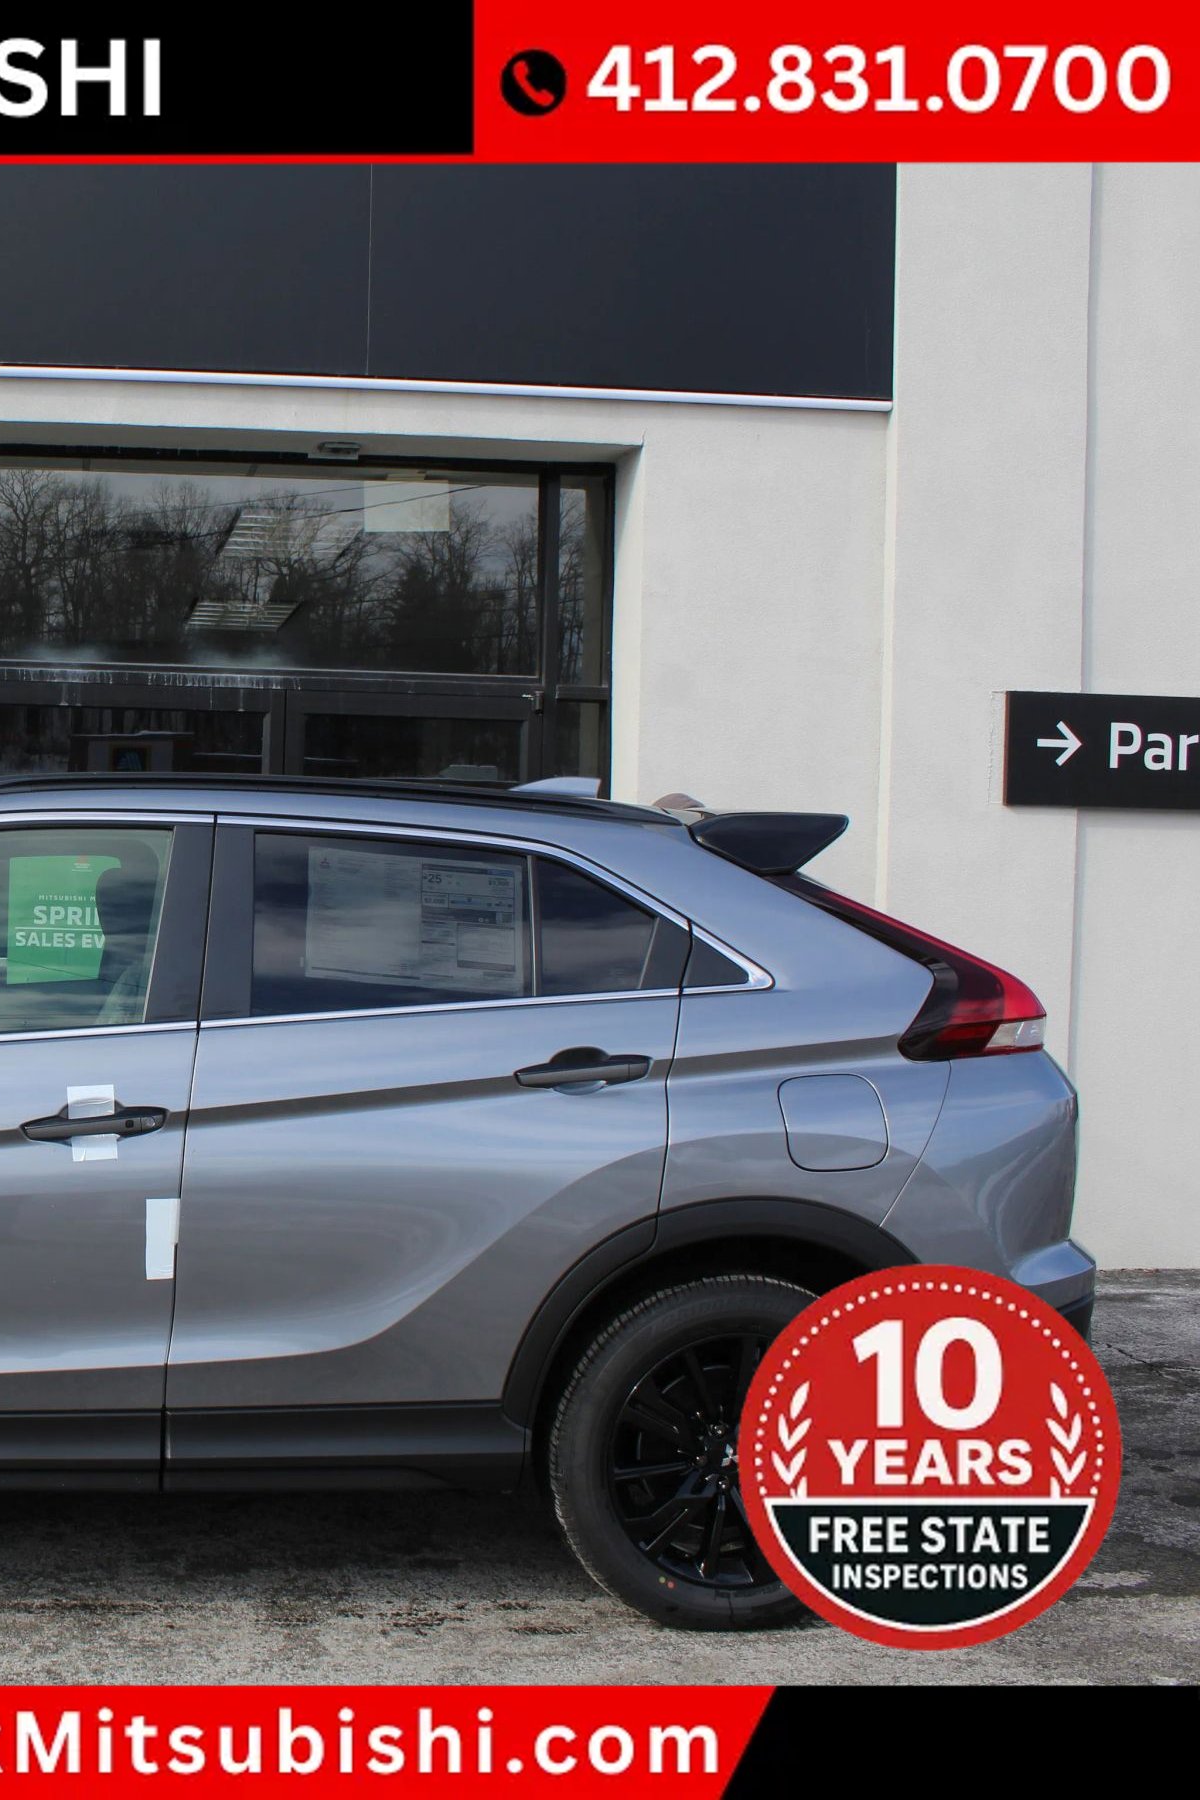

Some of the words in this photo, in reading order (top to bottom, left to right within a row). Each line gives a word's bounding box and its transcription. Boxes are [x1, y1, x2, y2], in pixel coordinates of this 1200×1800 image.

[1109, 722, 1199, 771] Par
[39, 894, 86, 902] MITSUBISHI
[15, 932, 75, 948] SALES
